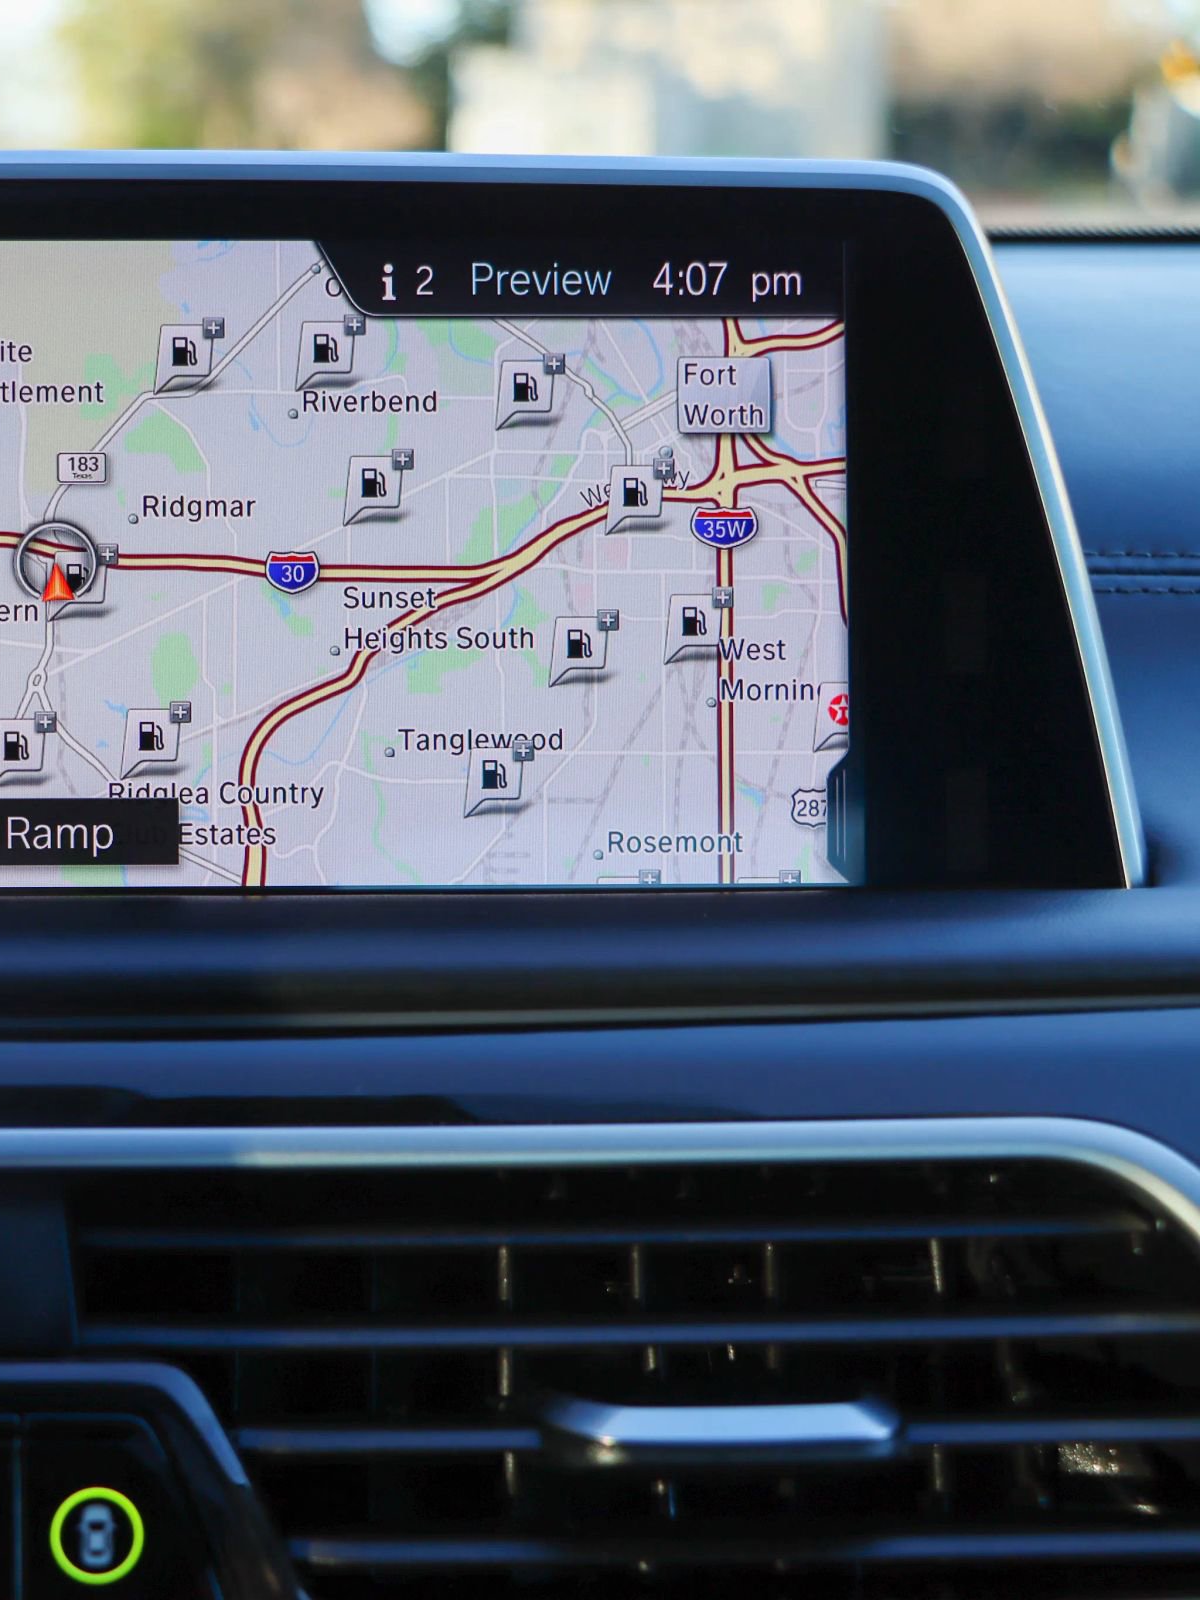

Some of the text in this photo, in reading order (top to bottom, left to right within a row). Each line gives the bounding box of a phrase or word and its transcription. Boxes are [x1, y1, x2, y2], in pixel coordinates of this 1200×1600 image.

[416, 266, 434, 296] 2
[471, 262, 612, 296] Preview
[653, 262, 802, 302] 4:07 pm
[684, 363, 737, 386] Fort
[303, 390, 438, 413] Riverbend
[684, 403, 765, 427] Worth
[67, 456, 100, 473] 183
[142, 494, 256, 521] Ridgmar
[703, 520, 747, 538] 35W
[280, 565, 306, 583] 30
[343, 586, 437, 610] Sunset
[344, 626, 534, 653] Heights South
[720, 638, 786, 661] West
[721, 679, 821, 701] Mornin
[220, 782, 325, 809] Country
[6, 816, 115, 856] Ramp
[179, 822, 276, 845] Estates
[607, 830, 744, 855] Rosemont
